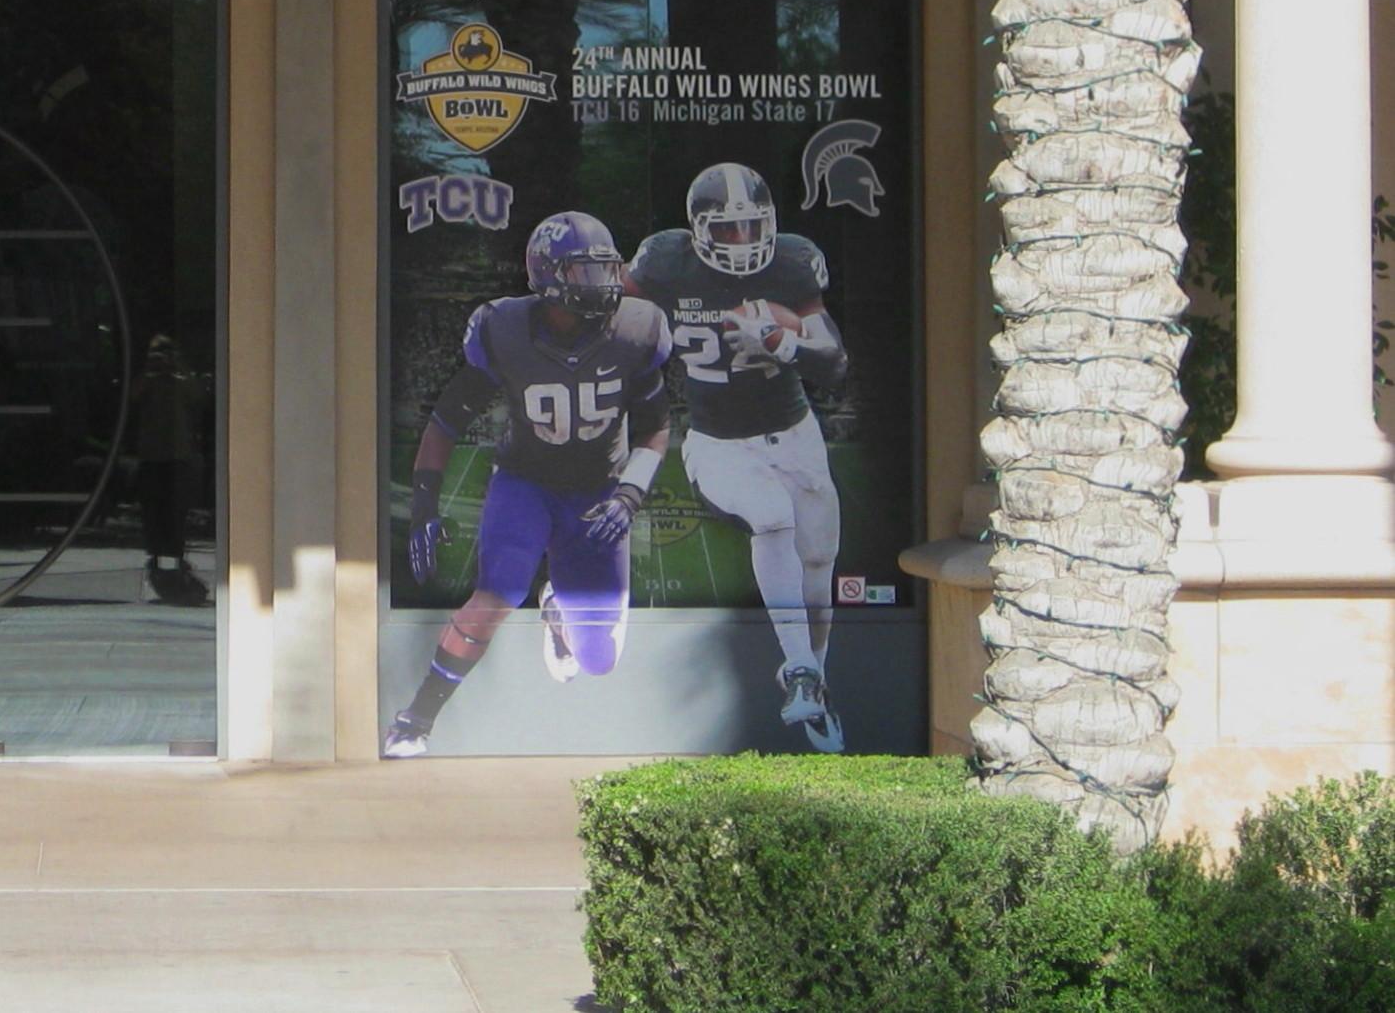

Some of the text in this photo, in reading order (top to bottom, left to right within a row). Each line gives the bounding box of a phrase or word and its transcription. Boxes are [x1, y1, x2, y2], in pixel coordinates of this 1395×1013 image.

[572, 46, 707, 70] 24TH ANNUAL
[406, 73, 547, 95] BUFFALO WILD WINGS
[572, 74, 882, 98] BUFFALO WILD WINGS BOWL
[445, 98, 509, 119] BOWL
[571, 100, 836, 125] TCU 16 Michigan State 17
[399, 174, 514, 234] TCU
[673, 324, 744, 384] 2
[524, 378, 622, 445] 95
